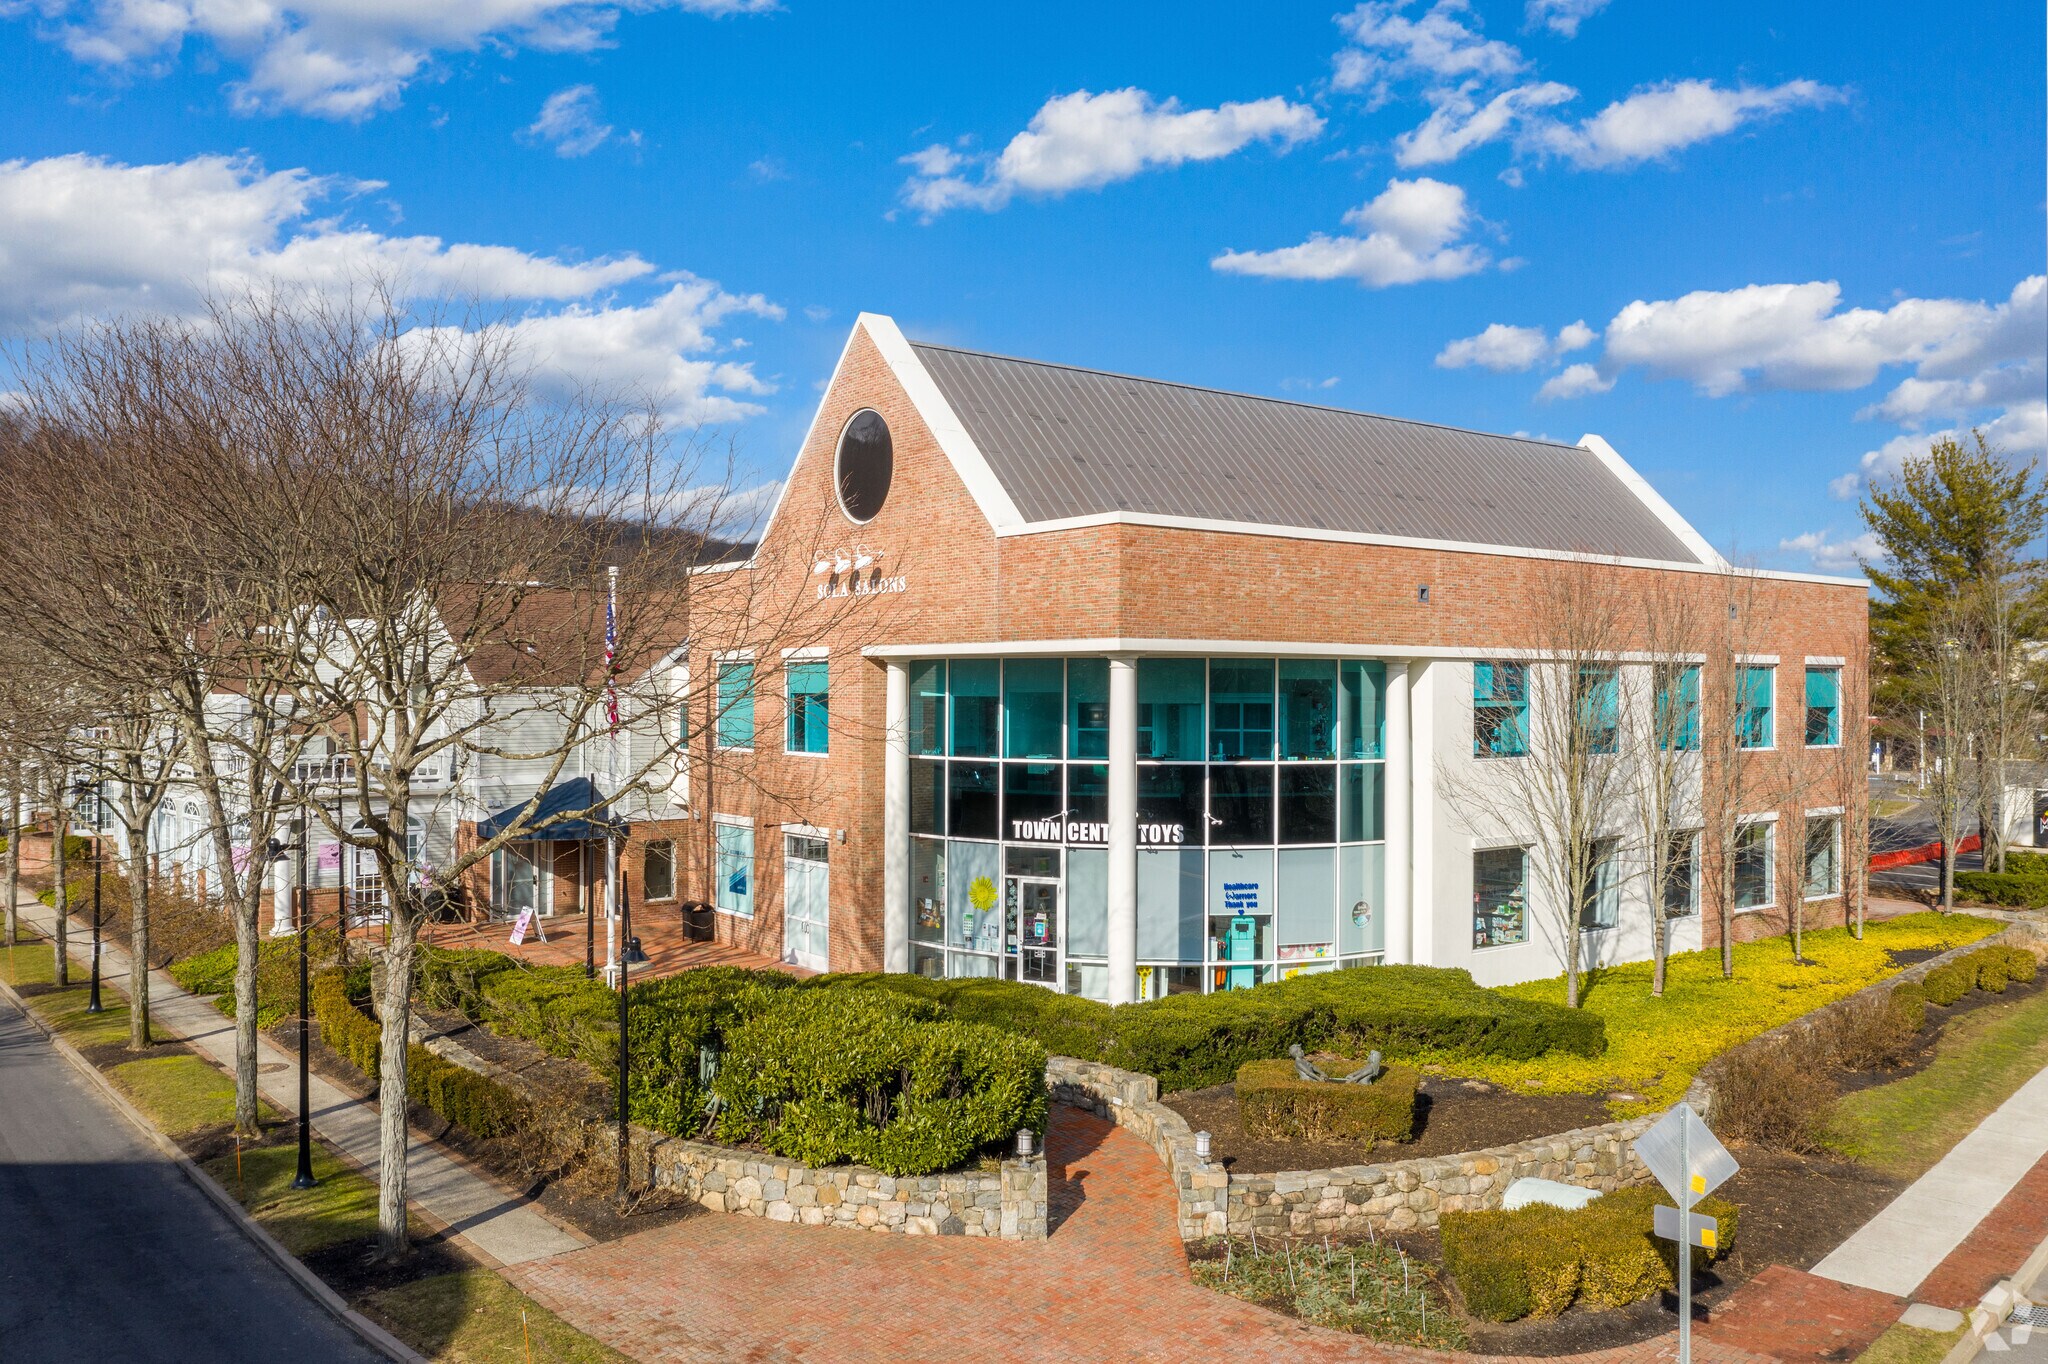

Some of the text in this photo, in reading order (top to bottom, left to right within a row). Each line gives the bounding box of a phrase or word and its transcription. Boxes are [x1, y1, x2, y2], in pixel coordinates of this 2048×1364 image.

[817, 576, 906, 599] SOLA SALONS
[1012, 820, 1184, 843] TOWN CENT TOYS
[1223, 882, 1259, 891] Healthcare
[1224, 900, 1244, 909] Thank
